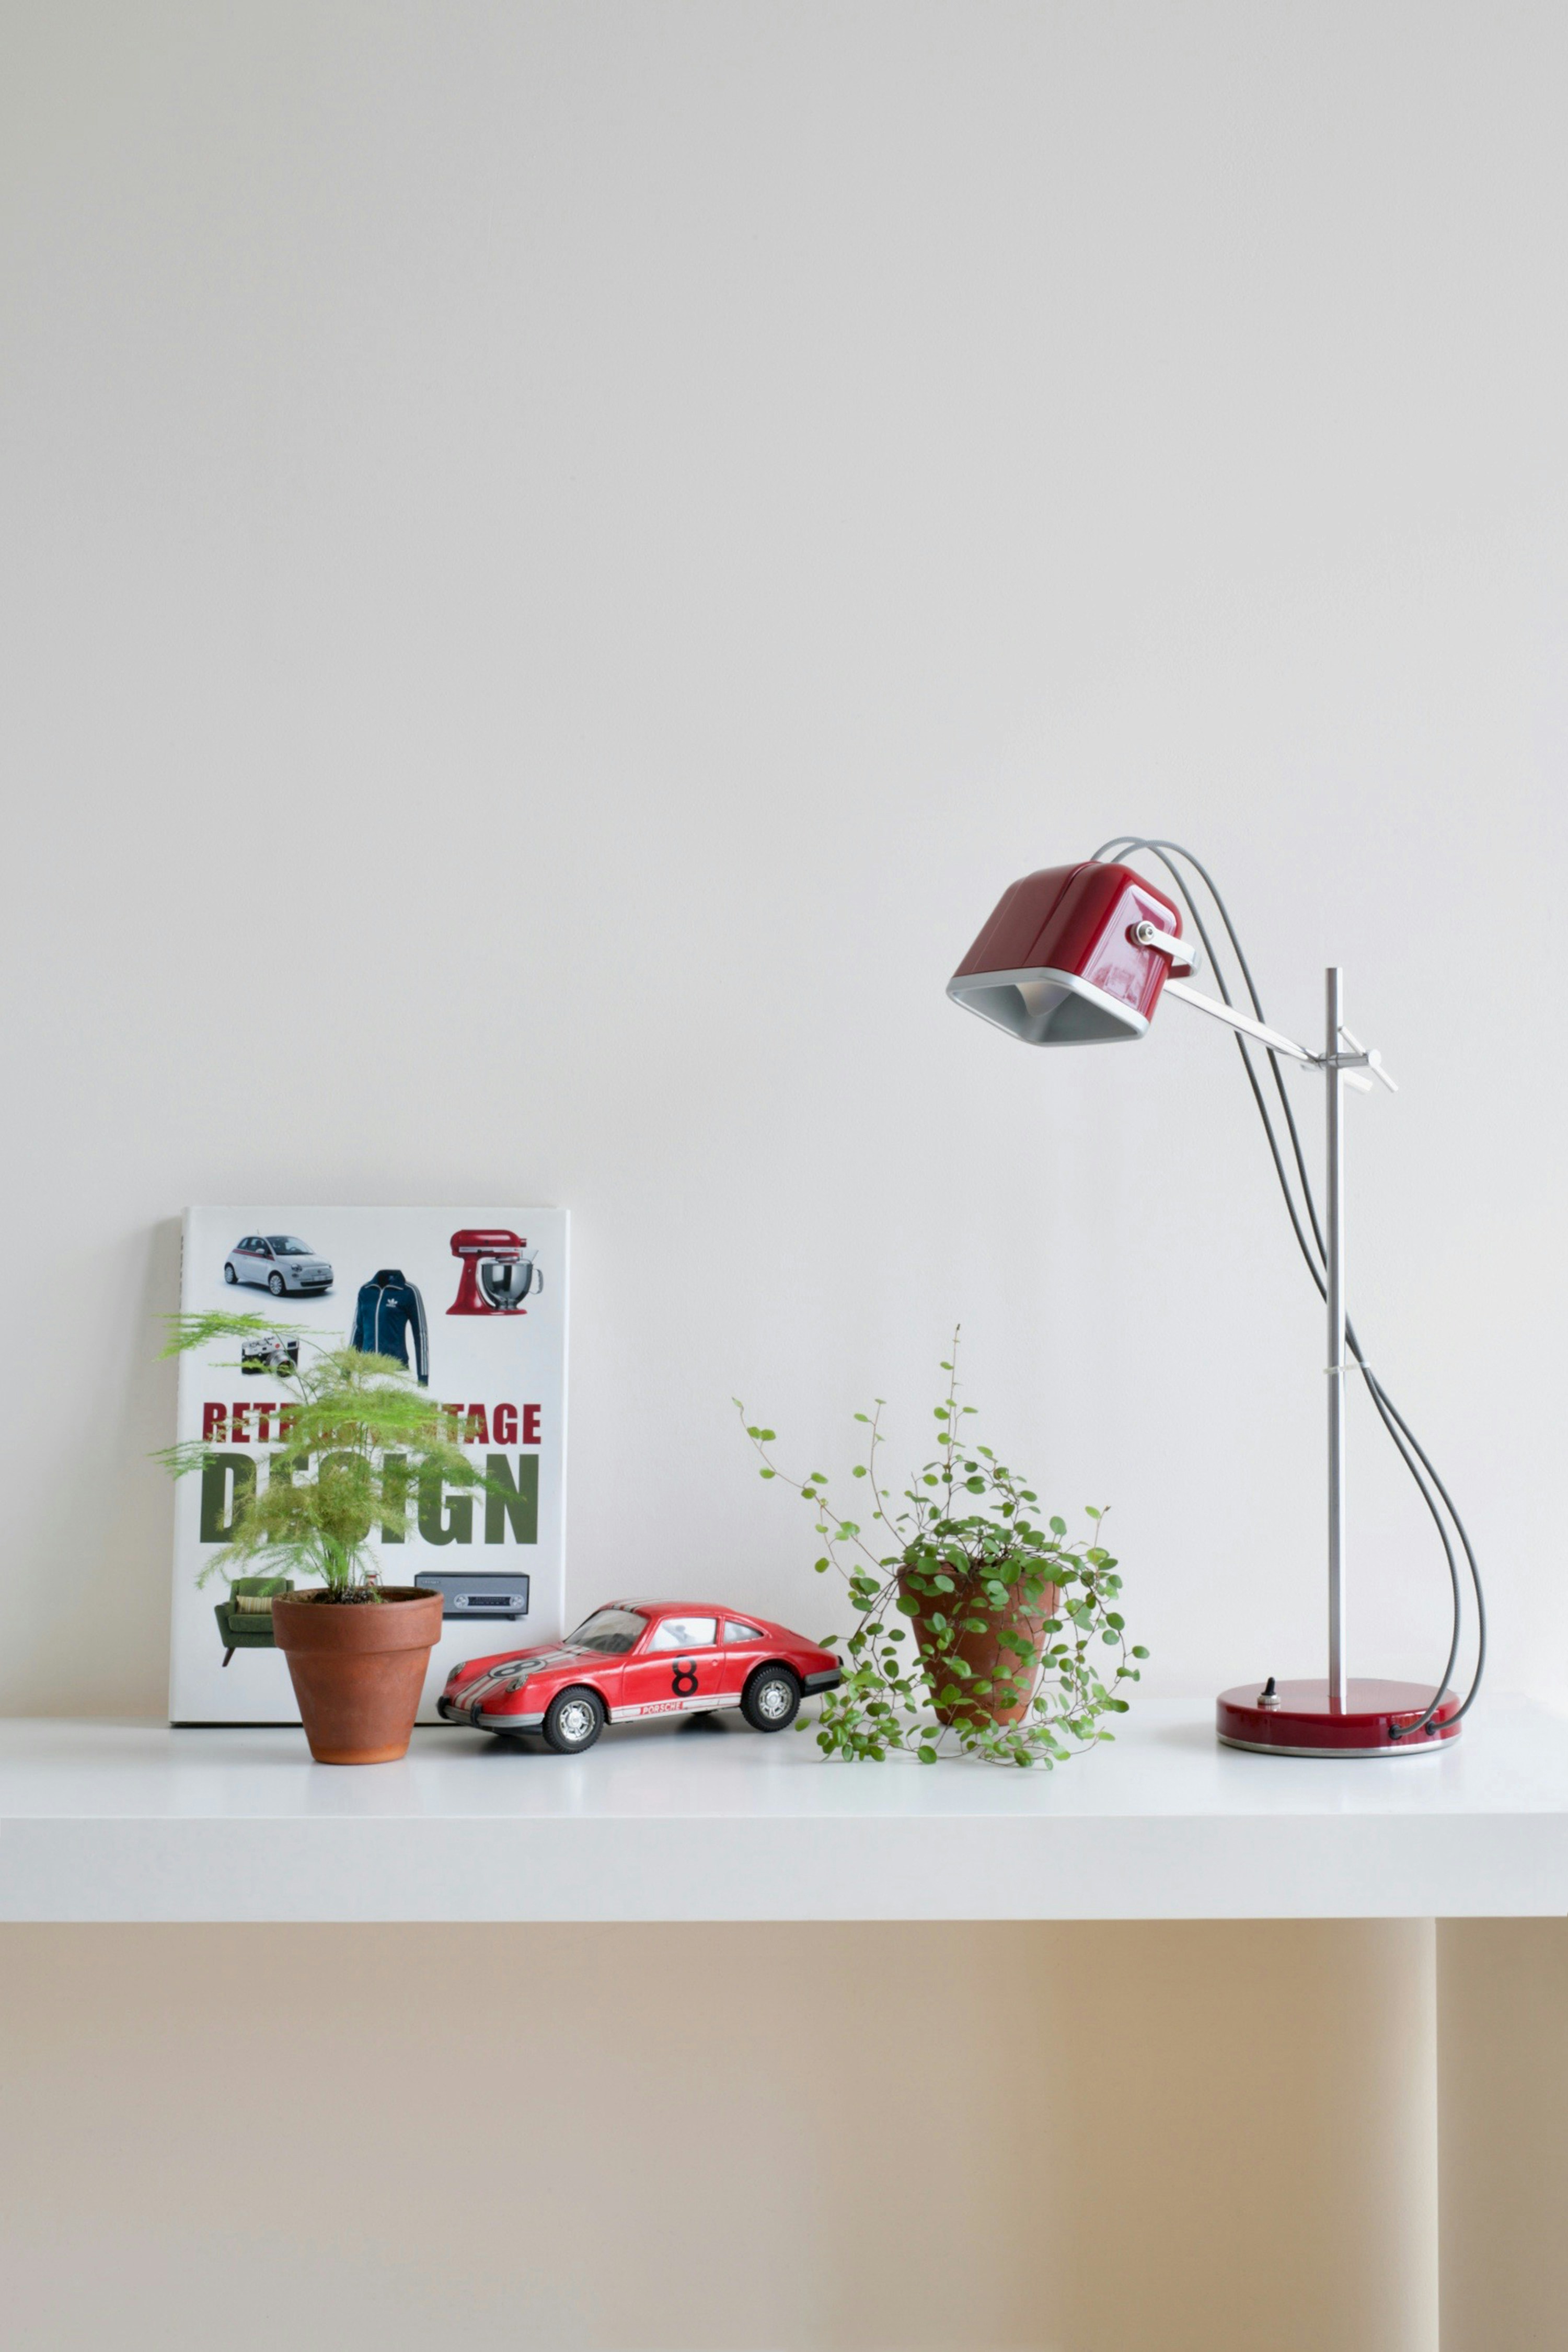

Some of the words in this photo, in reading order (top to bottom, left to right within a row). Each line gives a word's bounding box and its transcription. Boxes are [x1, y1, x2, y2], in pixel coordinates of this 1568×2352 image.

[493, 1661, 541, 1677] 8
[672, 1654, 698, 1698] 8
[642, 1702, 680, 1714] PORSCHE
